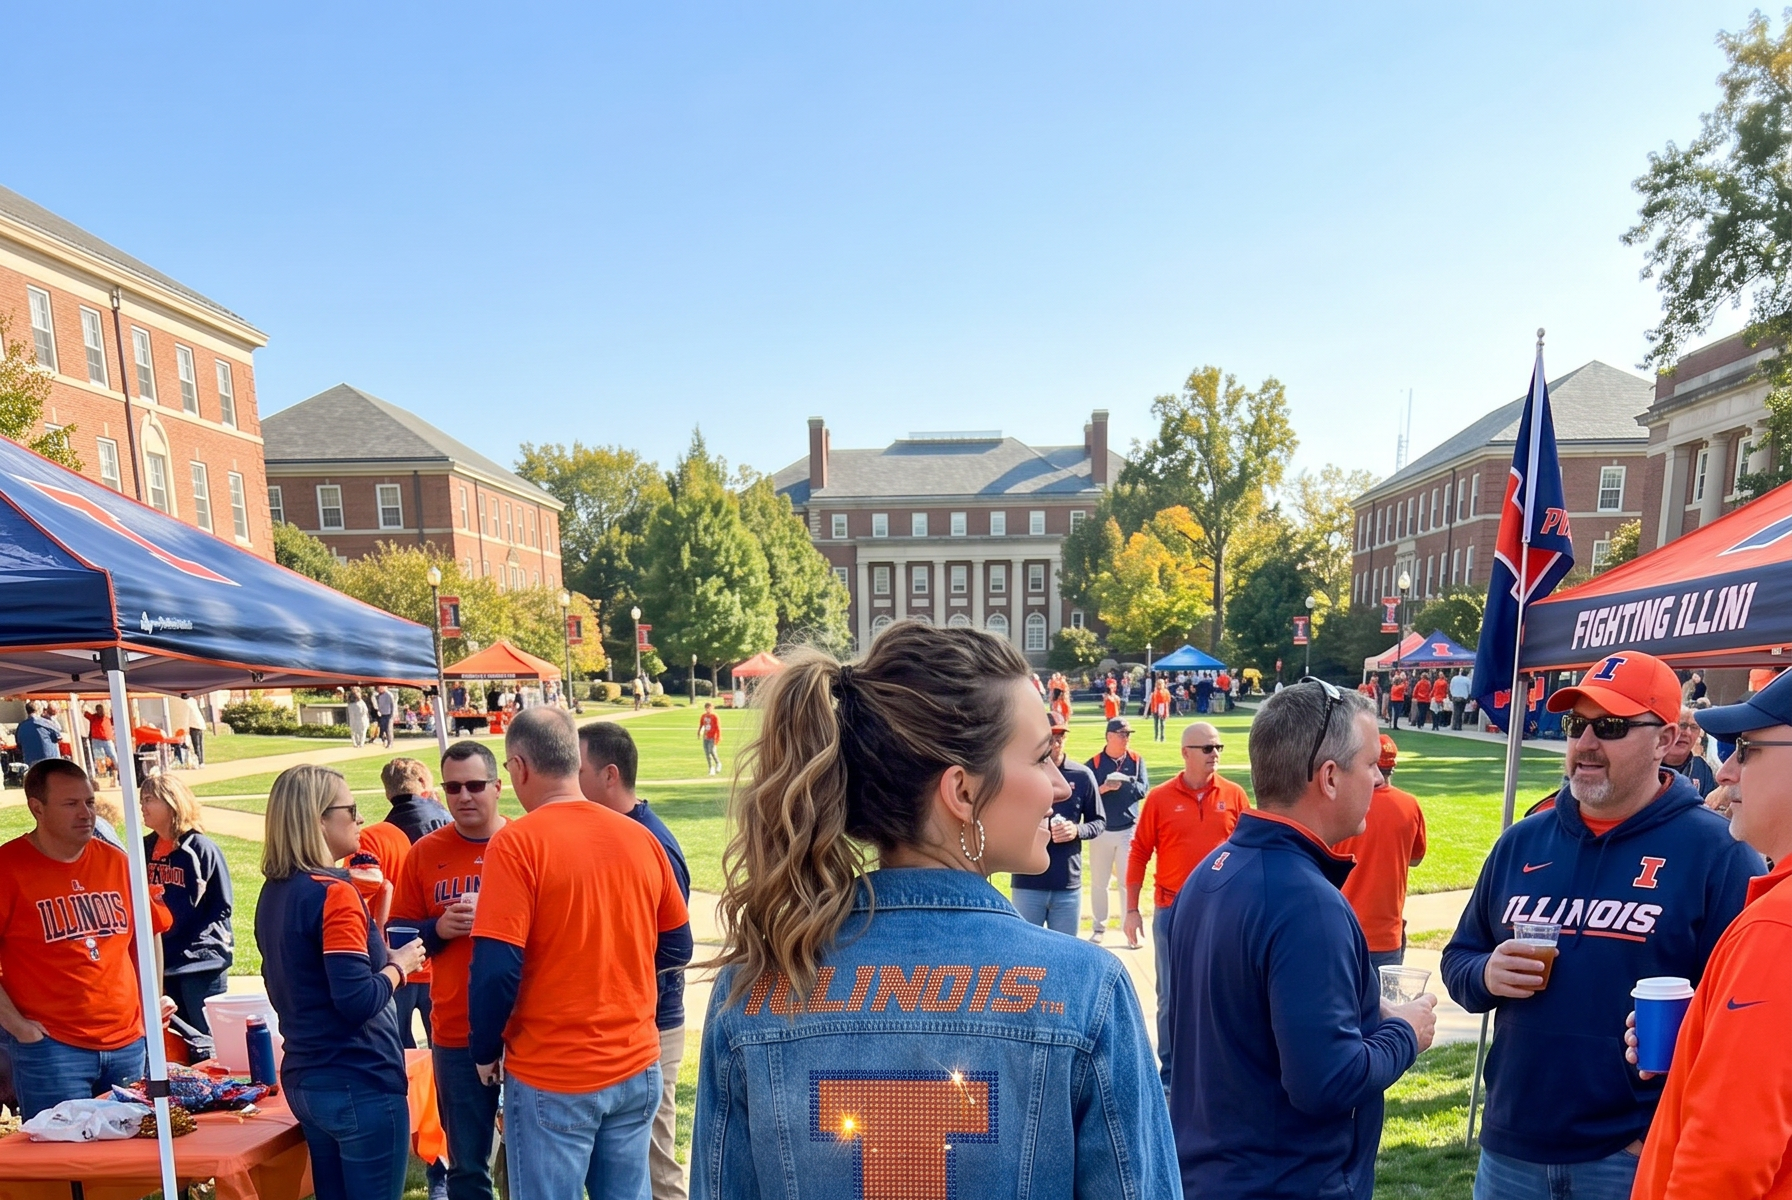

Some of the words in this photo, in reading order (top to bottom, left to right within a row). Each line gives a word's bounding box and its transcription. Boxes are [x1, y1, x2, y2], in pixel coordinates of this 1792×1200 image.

[1570, 595, 1676, 651] FIGHTING
[1672, 581, 1758, 638] ILLINI
[1591, 657, 1629, 682] I
[1632, 855, 1667, 889] I
[36, 890, 129, 944] ILLINOIS
[1501, 895, 1664, 934] ILLINOIS
[744, 964, 1047, 1015] ILLINOIS
